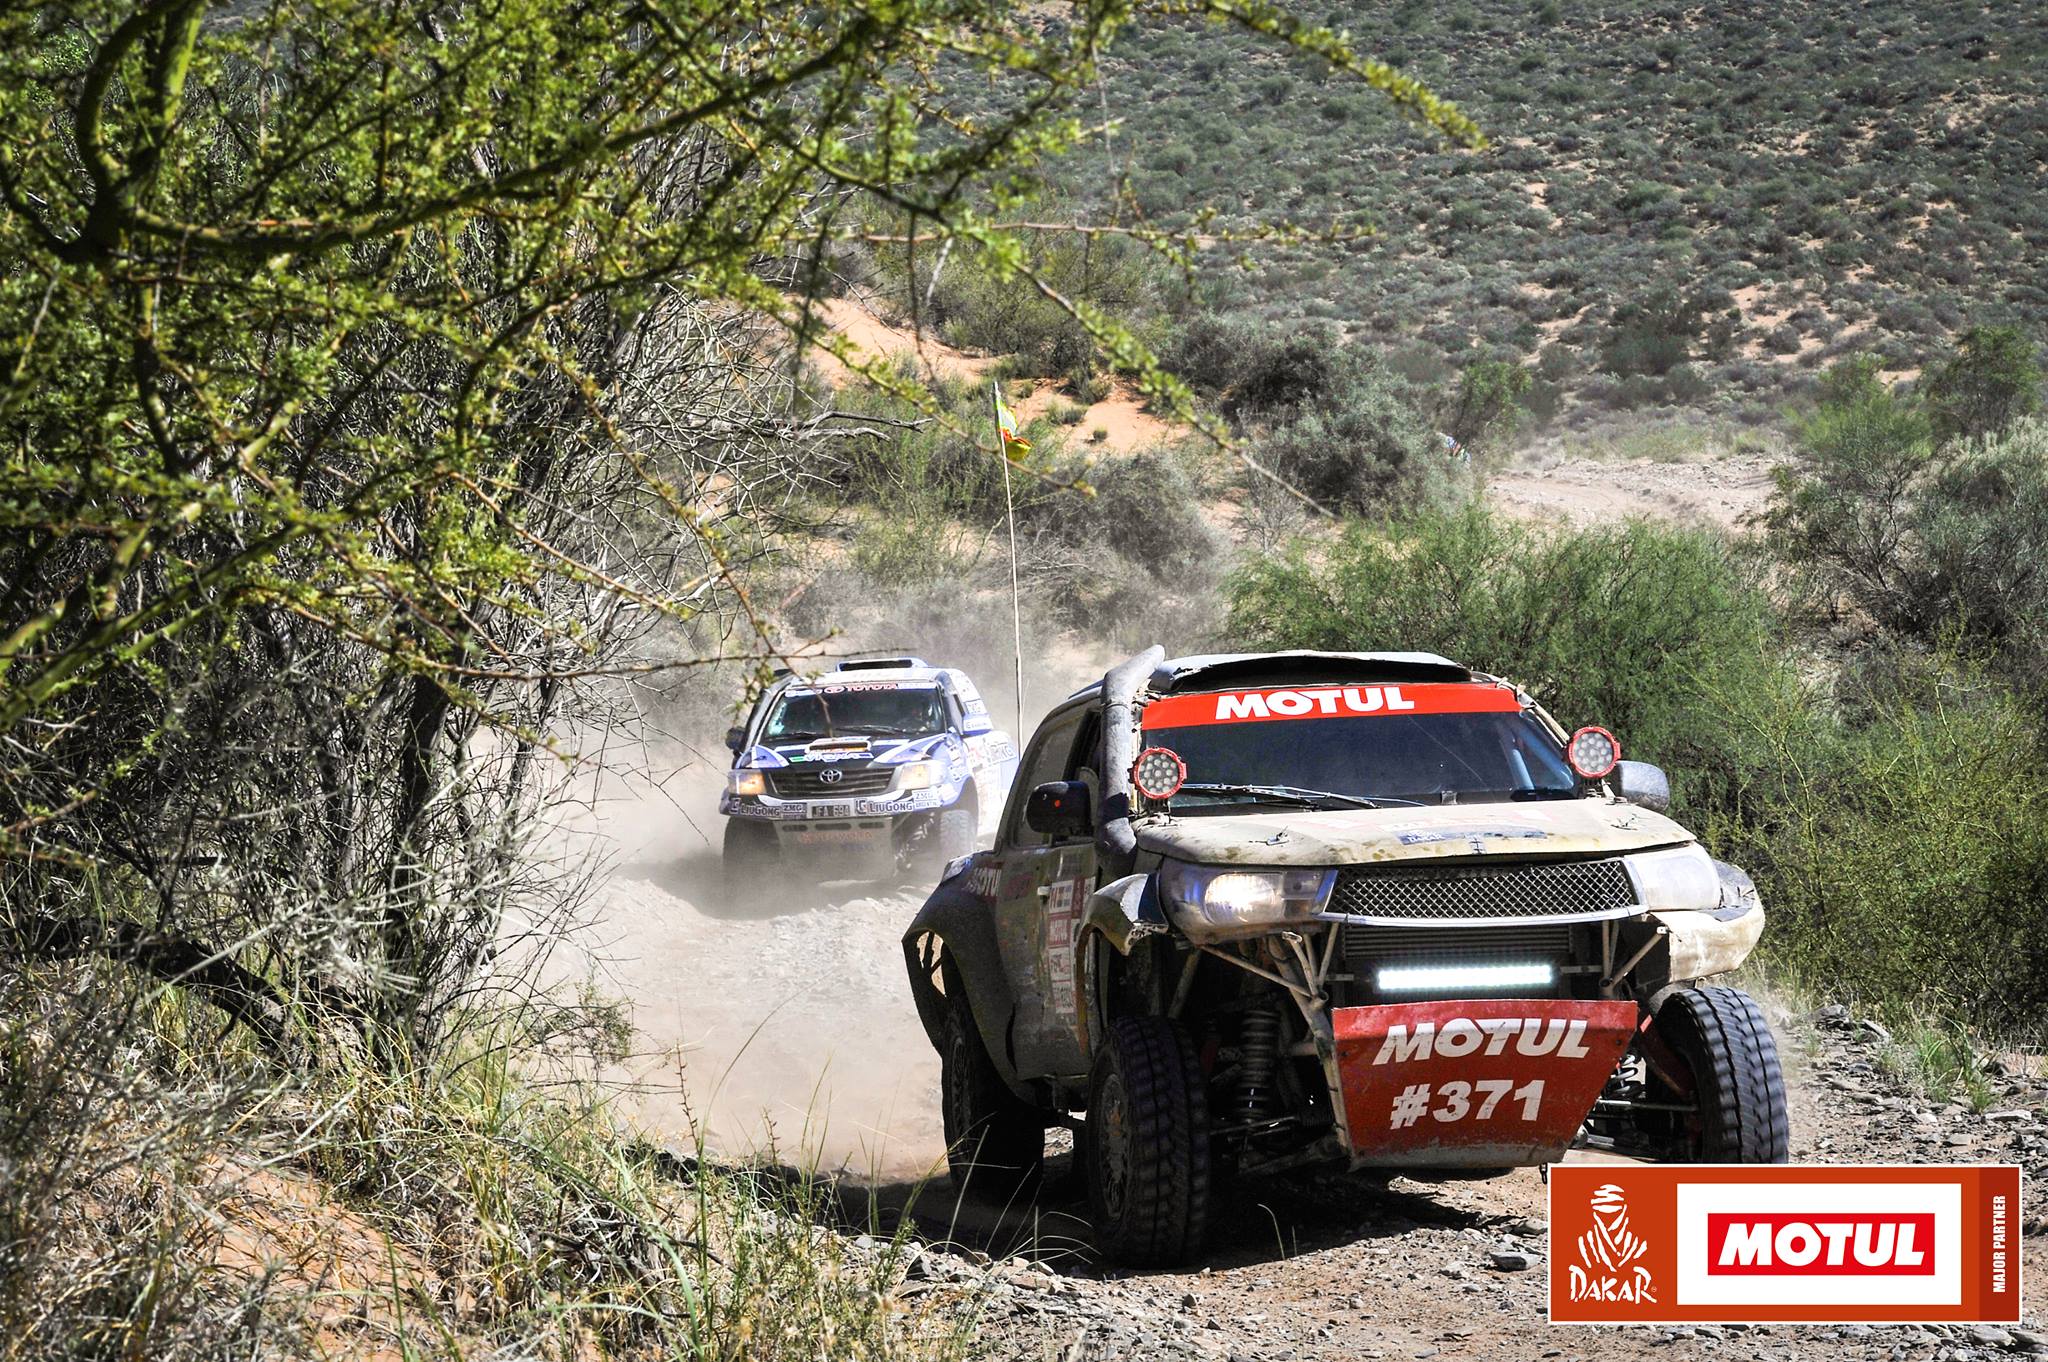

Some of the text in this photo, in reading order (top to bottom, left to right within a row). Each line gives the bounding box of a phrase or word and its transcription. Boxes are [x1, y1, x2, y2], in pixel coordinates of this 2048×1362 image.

[846, 683, 897, 692] TOYOTA
[1215, 687, 1415, 720] MOTUL
[1372, 1018, 1590, 1066] MOTUL
[1390, 1080, 1545, 1130] #371
